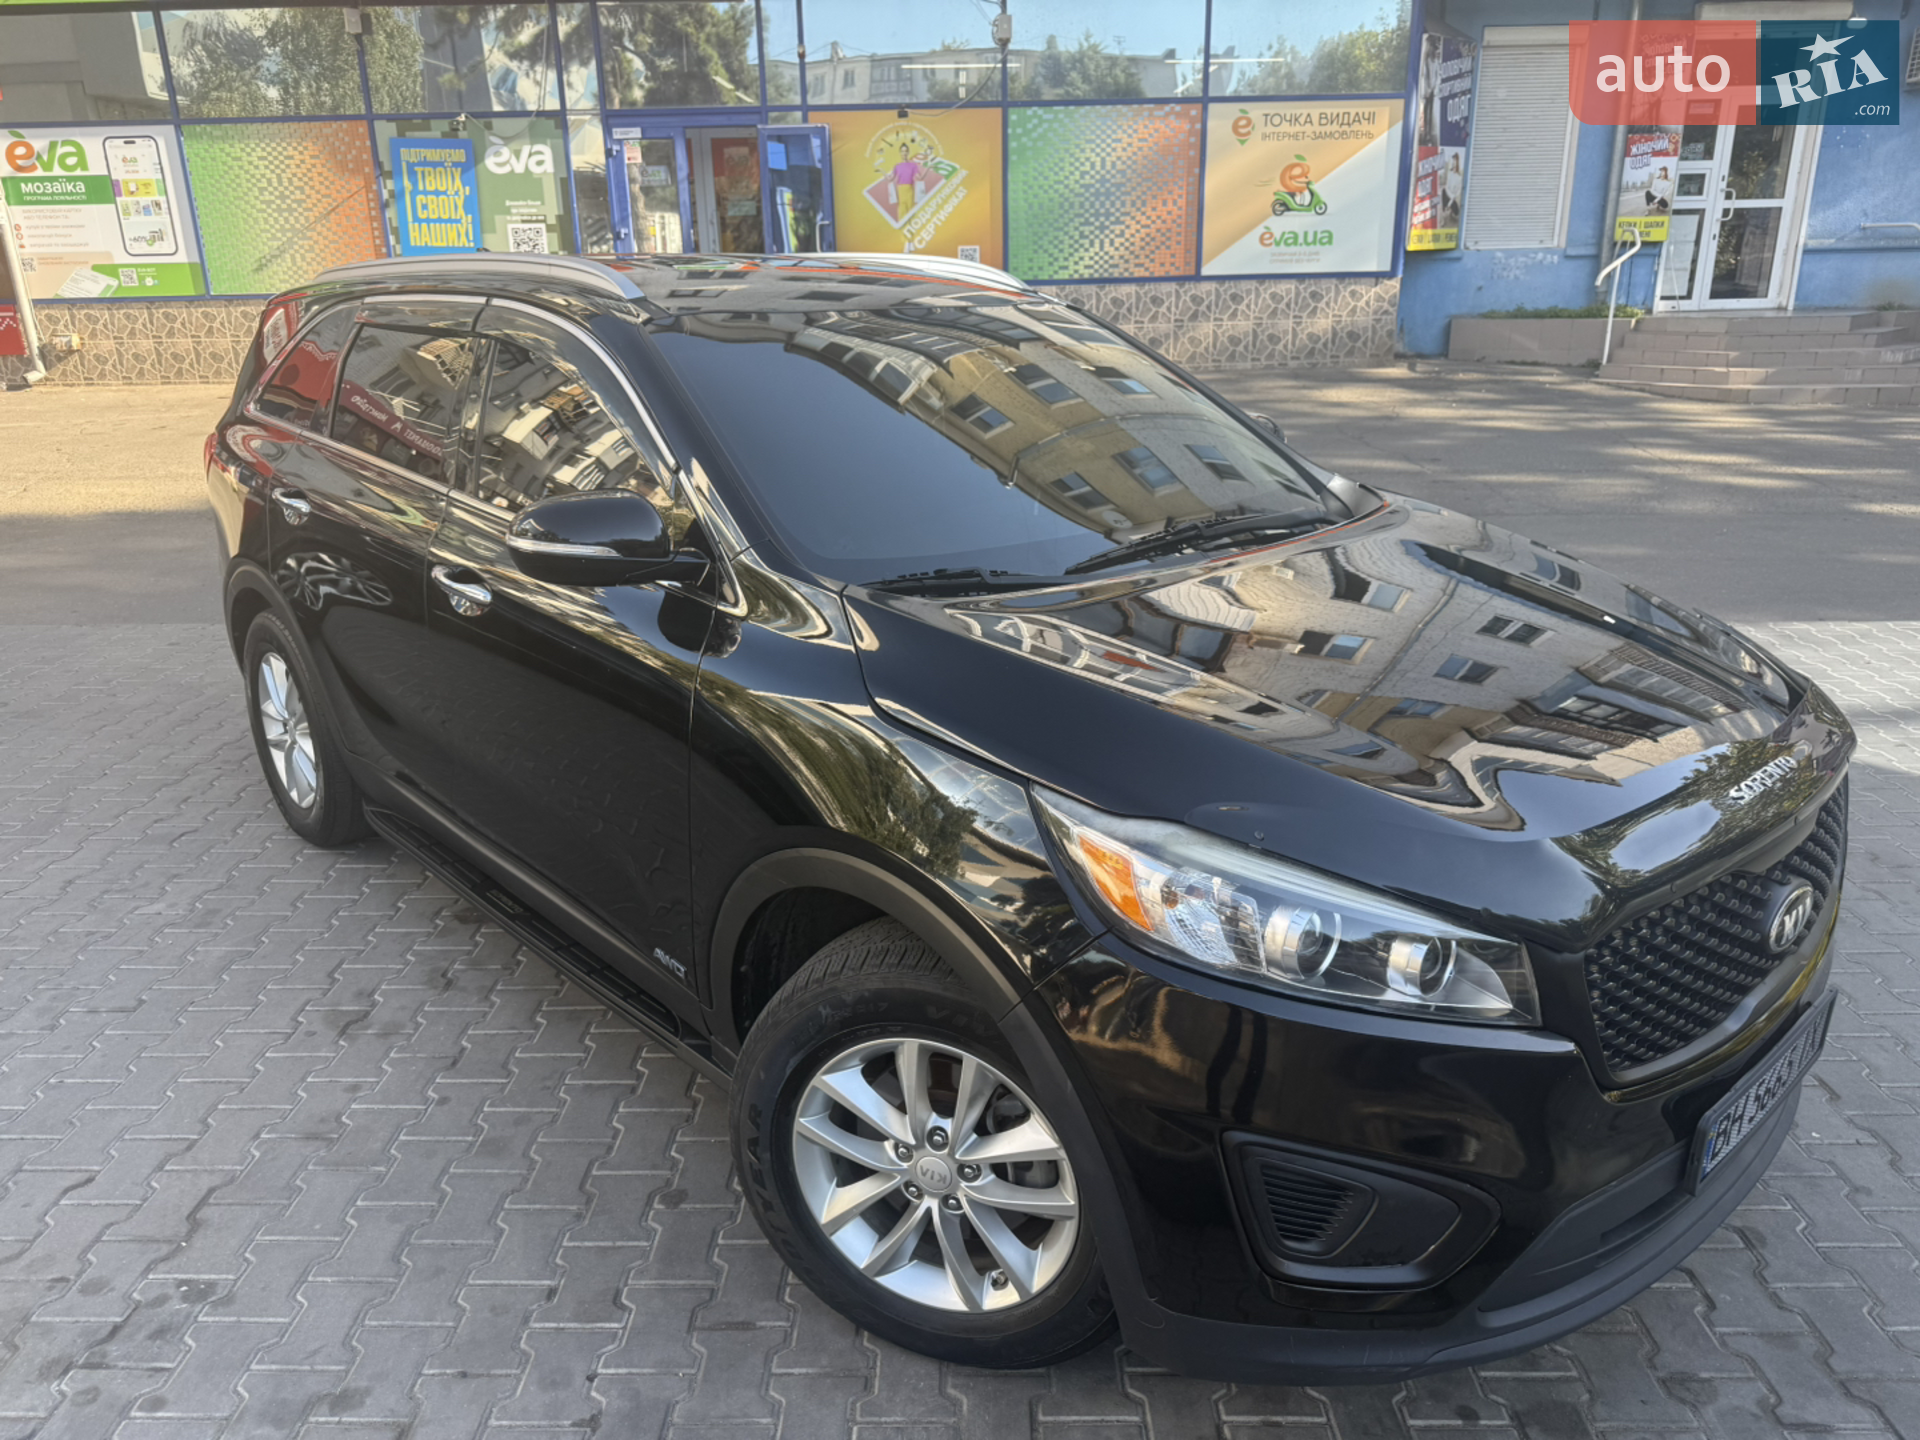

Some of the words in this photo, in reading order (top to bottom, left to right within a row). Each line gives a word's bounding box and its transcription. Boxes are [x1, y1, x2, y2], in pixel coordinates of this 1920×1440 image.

[1262, 113, 1314, 127] ТОЧКА
[1318, 111, 1376, 128] ВИДАЧІ
[1261, 130, 1374, 142] ІНТЕРНЕТ-ЗАМОВЛЕНЬ
[400, 148, 467, 163] ПІДТРИМУЄМО
[20, 178, 86, 194] мозаїка
[903, 169, 969, 239] ПОДАРУНКОВИЙ
[913, 185, 968, 249] СЕРТИФІКАТ
[408, 223, 475, 248] НАШИХ!
[1729, 756, 1798, 803] SORENTO
[919, 1164, 948, 1185] KIA
